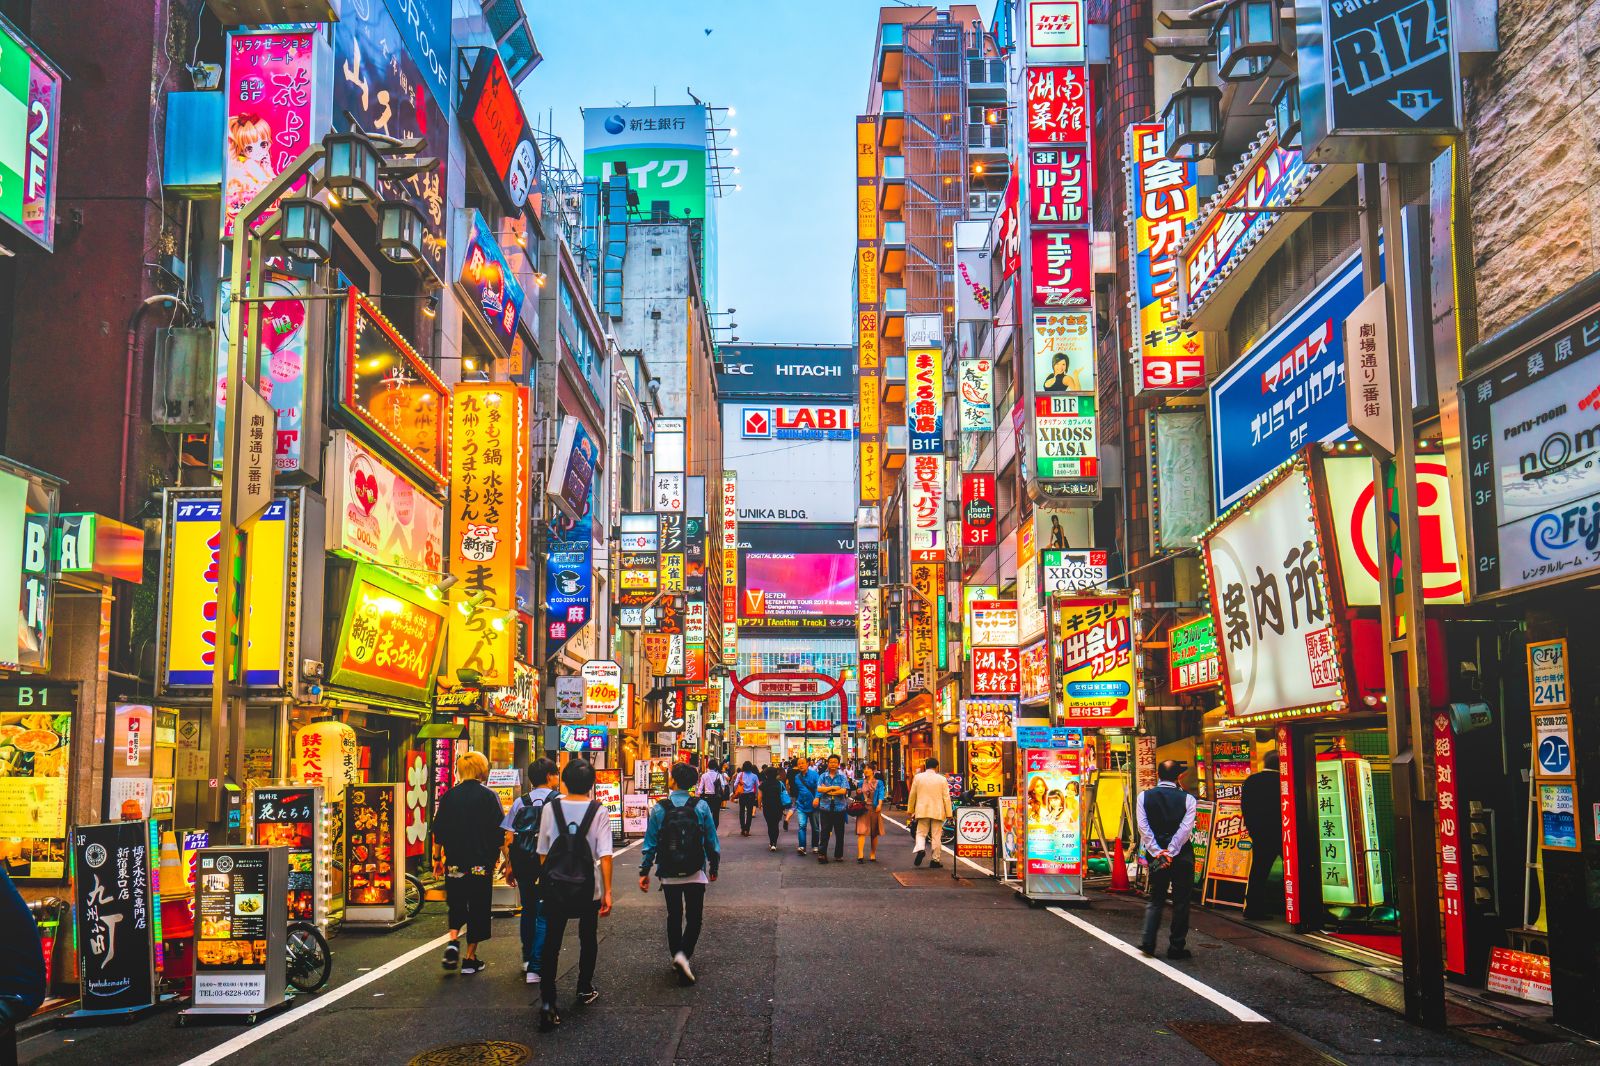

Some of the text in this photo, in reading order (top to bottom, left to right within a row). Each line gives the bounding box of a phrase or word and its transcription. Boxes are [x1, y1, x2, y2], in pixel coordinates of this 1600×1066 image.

[1035, 22, 1073, 32] ラウンジ
[1039, 14, 1071, 23] カブキ
[235, 39, 310, 51] リラクゼーション
[1333, 1, 1448, 96] RIZ
[240, 80, 265, 90] 当ビル
[240, 91, 262, 101] 6F
[1401, 93, 1430, 109] B1
[629, 117, 686, 132] 新生銀行
[1048, 132, 1067, 142] 4F
[29, 100, 49, 200] 2F
[1036, 153, 1057, 163] 3F
[1061, 151, 1083, 221] レンタル
[1037, 169, 1058, 221] ルーム
[1047, 232, 1072, 287] エデン
[1036, 326, 1088, 337] マッサージ
[1265, 321, 1328, 393] マクロス
[776, 364, 842, 377] HITACHI
[1146, 359, 1201, 385] 3F
[1359, 322, 1380, 418] 劇場通り一番街
[915, 354, 935, 434] まぐろ商店
[1053, 398, 1077, 413] B1F
[775, 408, 847, 429] LABI
[1503, 403, 1567, 441] Party-room
[1038, 427, 1093, 442] XROSS
[1289, 422, 1308, 450] 2F
[1472, 434, 1489, 451] 5F
[912, 439, 941, 450] B1F
[1045, 442, 1087, 457] CASA
[247, 414, 264, 496] 劇場通り一番街
[460, 394, 480, 522] 九州のうまかもん
[1473, 462, 1490, 477] 4F
[483, 469, 504, 525] 水炊き
[1475, 490, 1493, 506] 3F
[724, 483, 735, 545] お好み焼き
[778, 510, 808, 520] BLDG.
[970, 529, 989, 543] 3F
[919, 552, 937, 561] 4F
[1479, 556, 1497, 573] 2F
[1049, 567, 1104, 580] XROSS
[862, 579, 876, 587] 3F
[1222, 540, 1325, 652] 案内所
[1066, 599, 1118, 632] キラリ
[1065, 618, 1126, 669] 出会い
[376, 633, 428, 678] まっちゃん
[1091, 648, 1130, 680] カフェ
[18, 687, 48, 705] B1
[1535, 683, 1566, 705] 24H
[865, 706, 876, 714] 2F
[1543, 740, 1568, 766] 2F
[987, 783, 1002, 793] B1
[259, 802, 310, 820] 花たろう
[1317, 773, 1340, 887] 無料案内所
[1215, 838, 1237, 850] キラリ
[958, 849, 993, 858] COFFEE
[117, 847, 130, 901] 新宿東口店
[133, 845, 151, 929] 博多水炊き専門店
